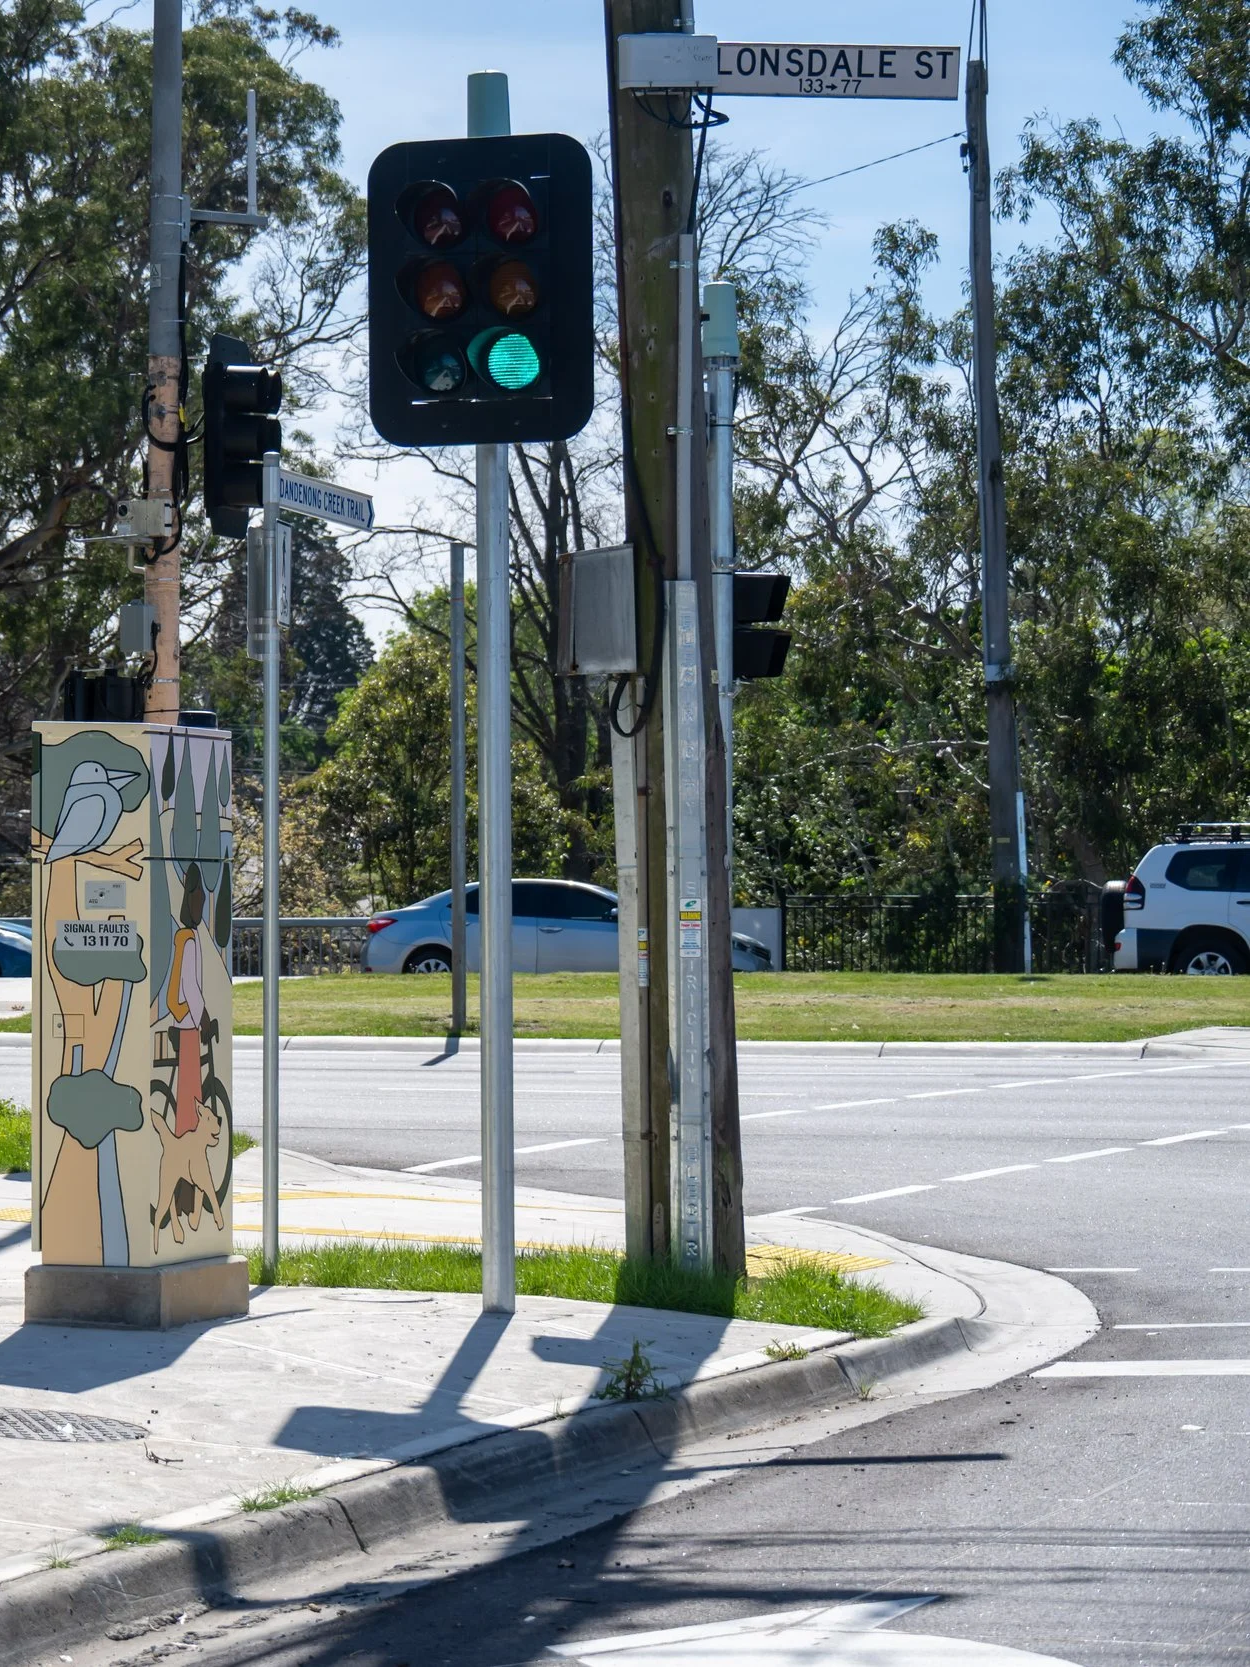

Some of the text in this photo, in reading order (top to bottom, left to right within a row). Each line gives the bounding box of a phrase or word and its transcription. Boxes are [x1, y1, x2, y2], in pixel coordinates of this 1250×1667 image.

[717, 47, 954, 80] LONSDALE ST
[798, 78, 862, 94] 133 77
[279, 479, 364, 522] DANDENONG CREEK TRAIL
[64, 924, 130, 933] SIGNAL FAULTS
[83, 936, 128, 947] 13 11 70
